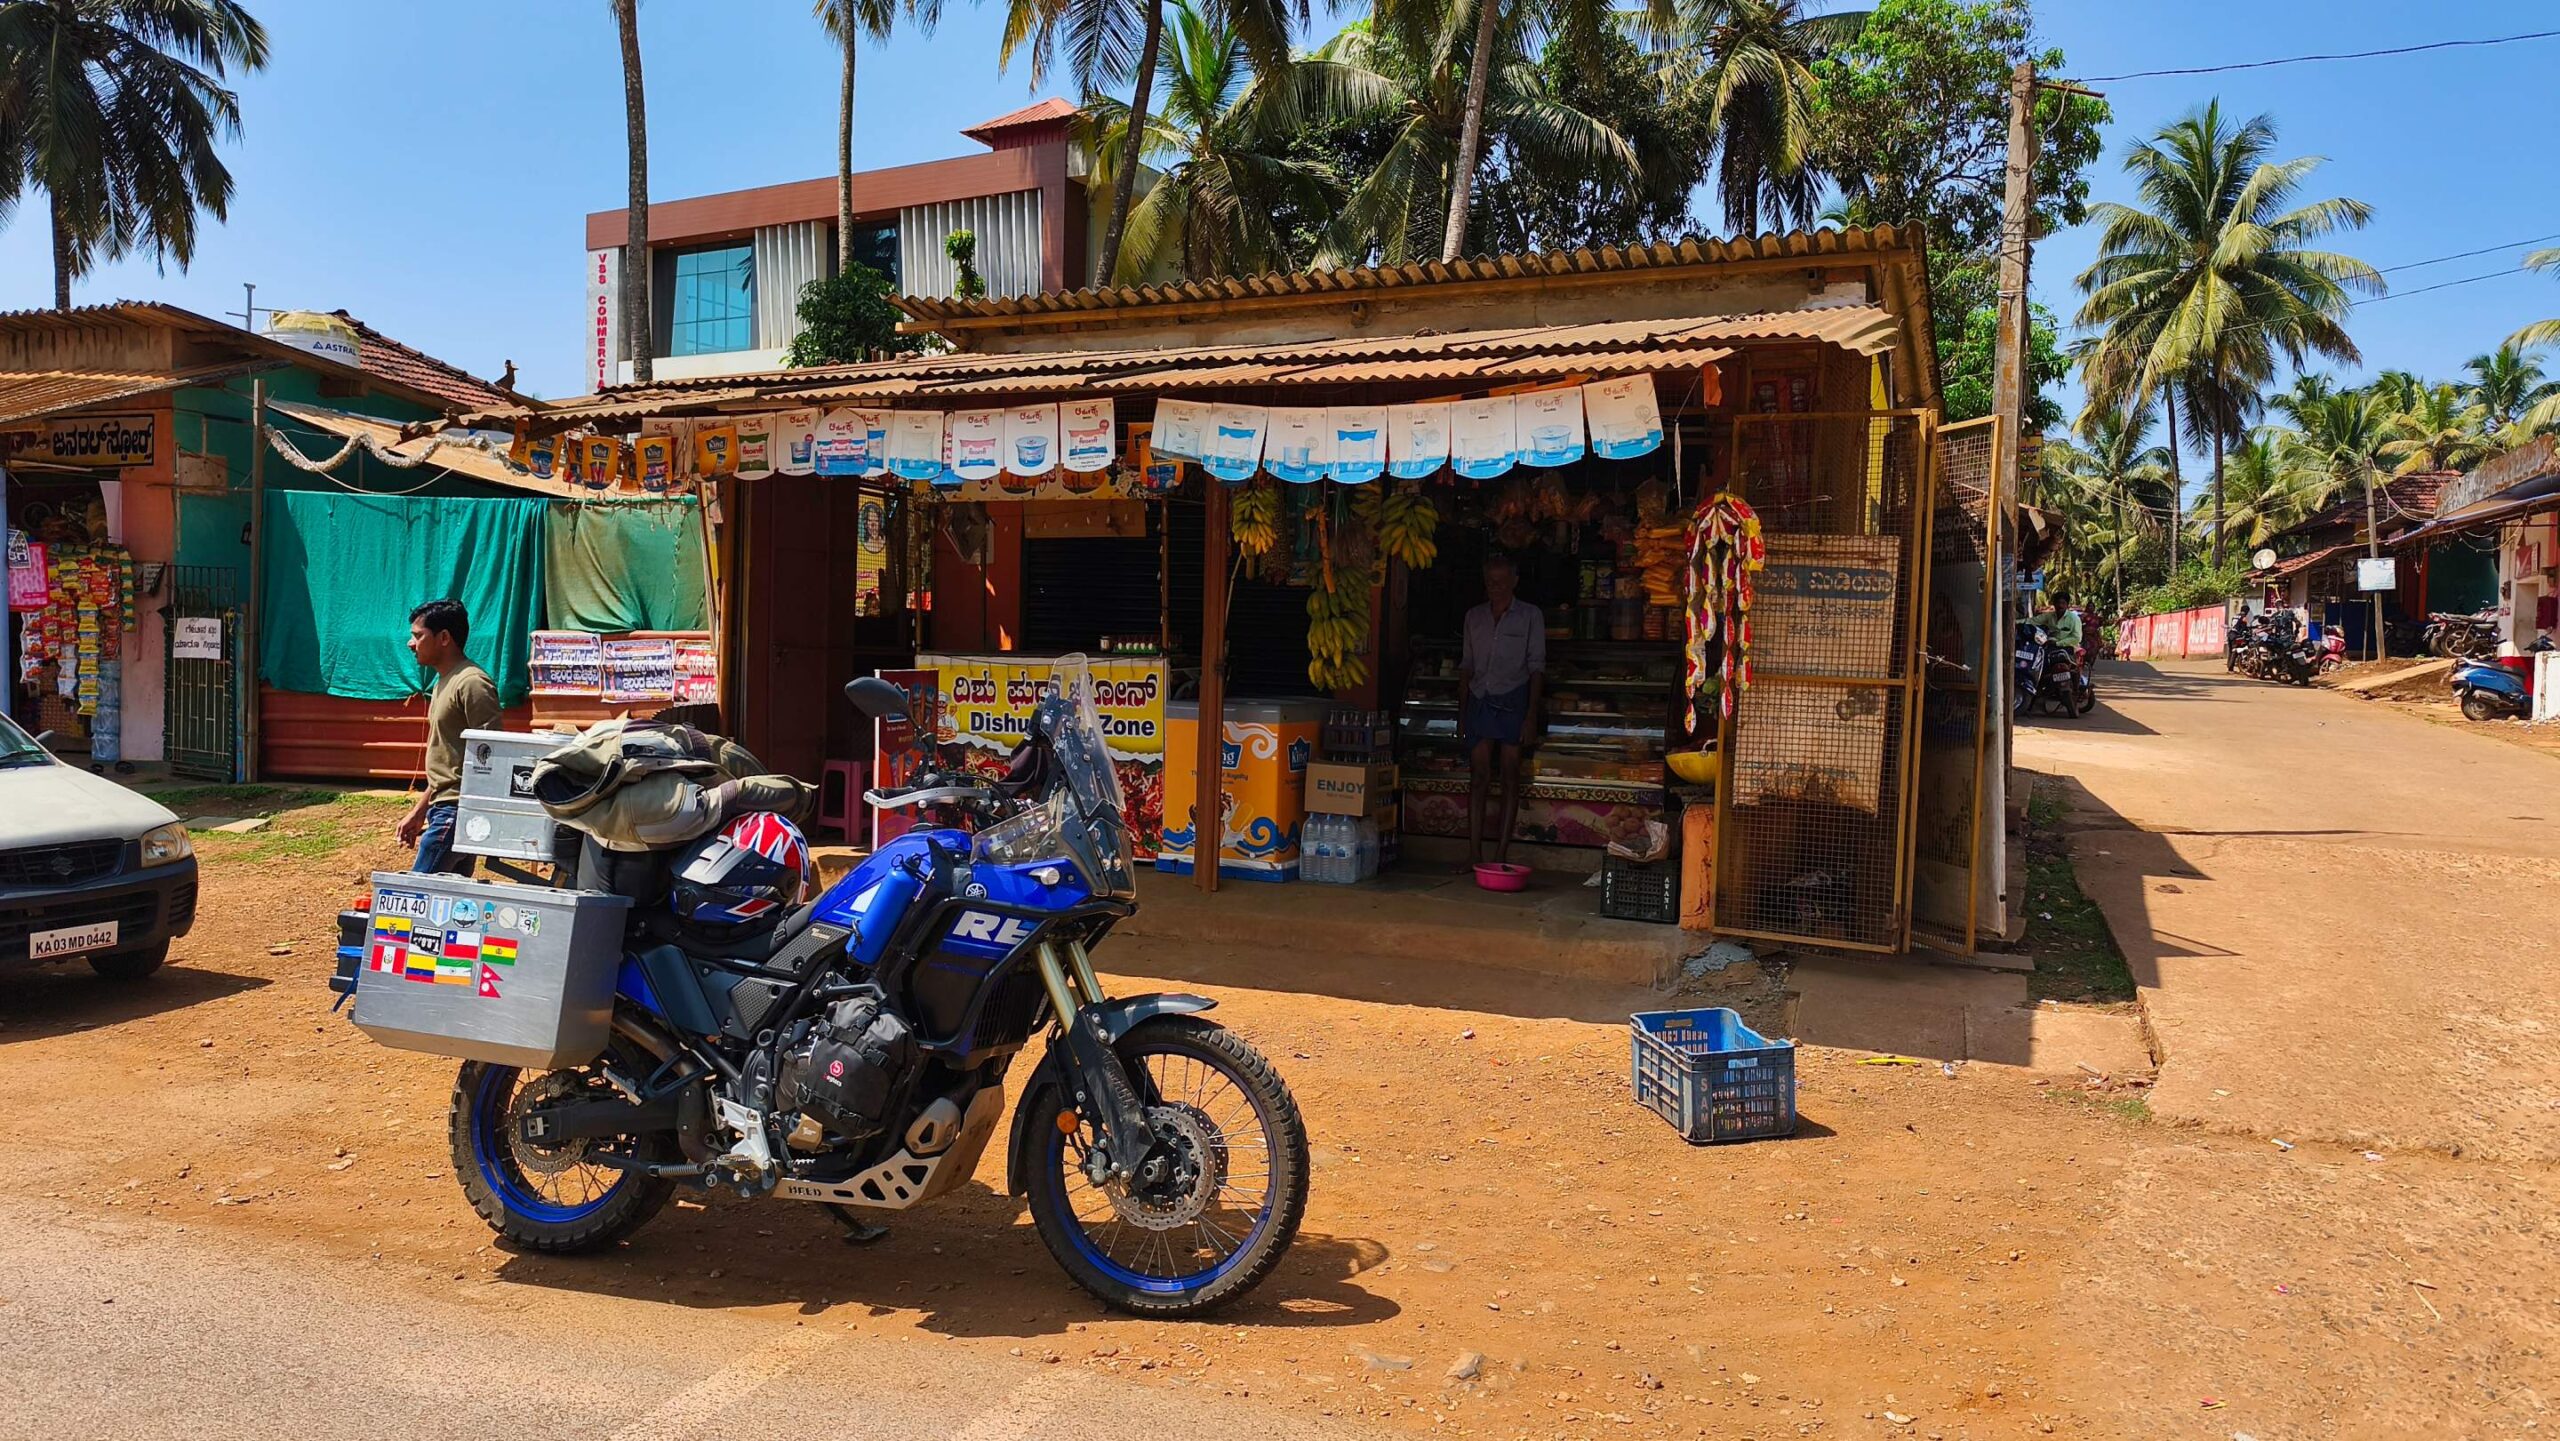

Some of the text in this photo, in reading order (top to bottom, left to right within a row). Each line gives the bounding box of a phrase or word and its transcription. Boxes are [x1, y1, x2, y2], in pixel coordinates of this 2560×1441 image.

[325, 343, 356, 356] ASTRAL
[970, 711, 1155, 736] Dishu Zone
[1317, 778, 1365, 794] ENJOY
[379, 895, 427, 915] RUTA 40
[36, 931, 112, 954] KA 03 MD 0442
[1700, 1077, 1709, 1125] SAM
